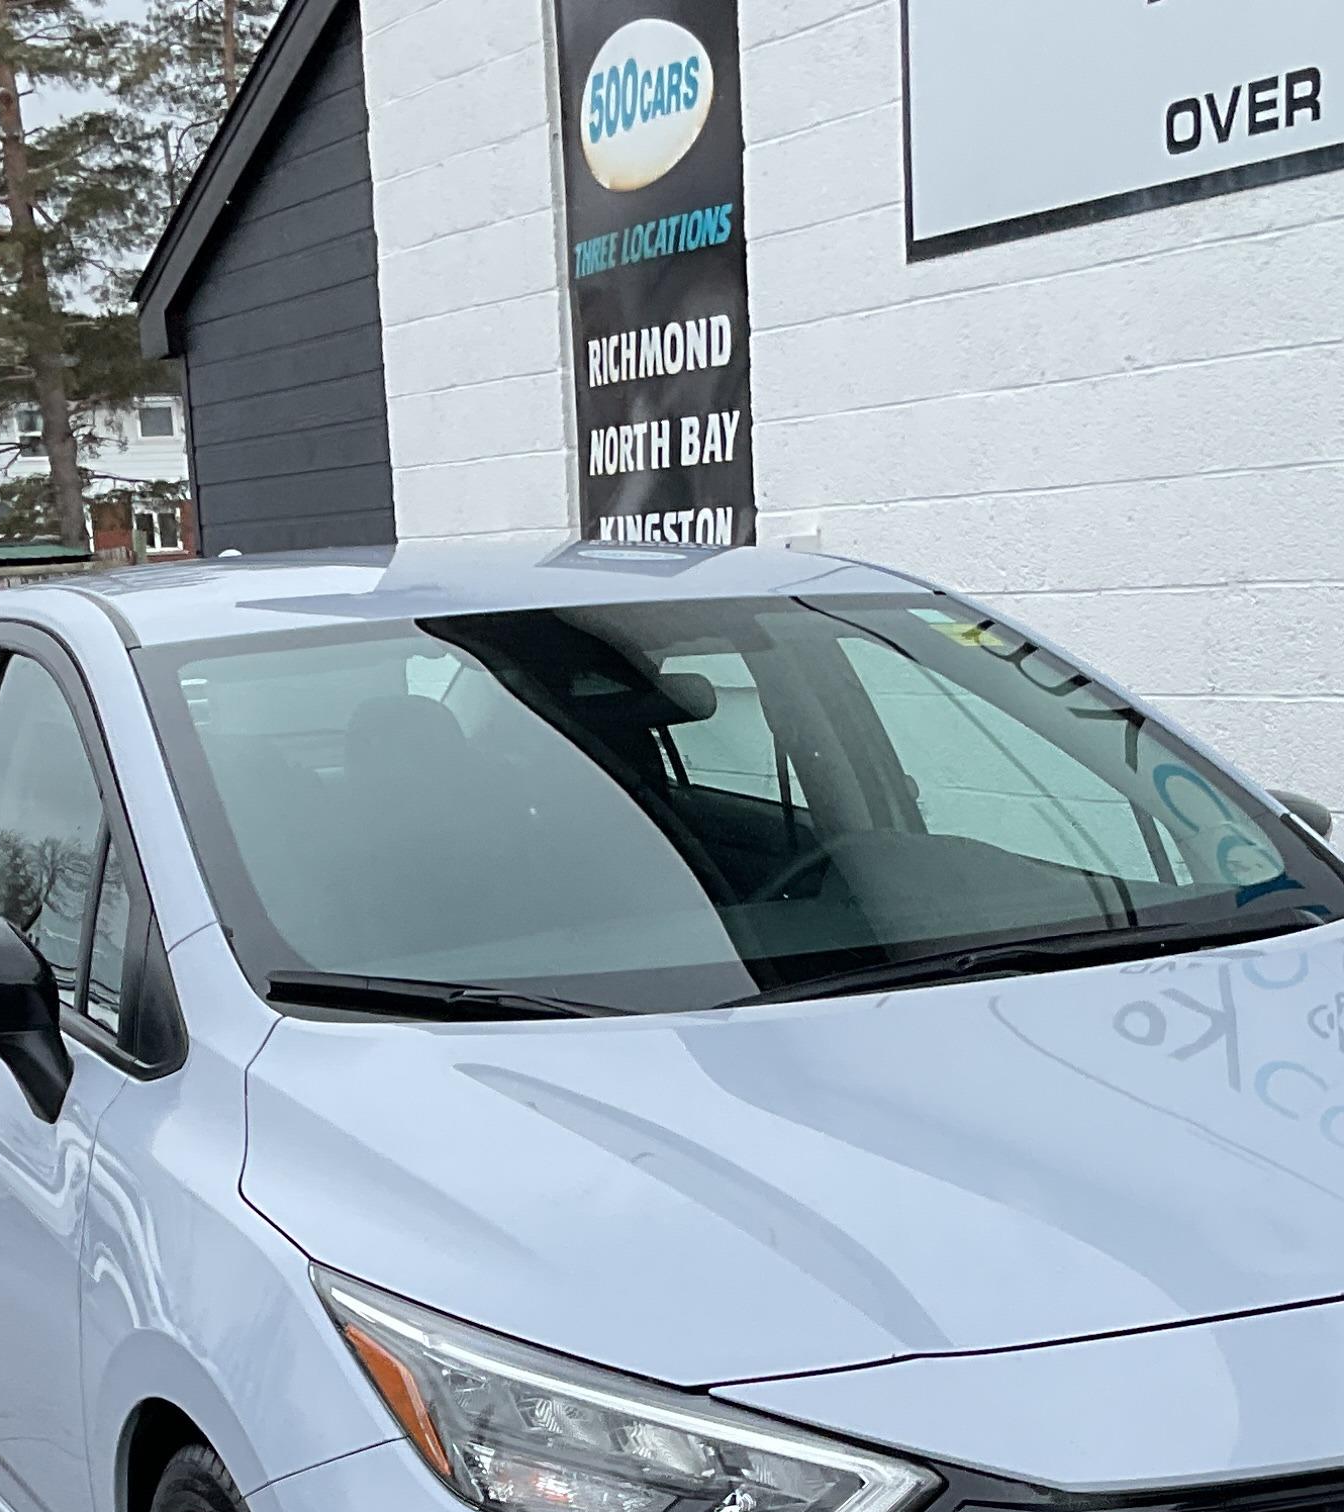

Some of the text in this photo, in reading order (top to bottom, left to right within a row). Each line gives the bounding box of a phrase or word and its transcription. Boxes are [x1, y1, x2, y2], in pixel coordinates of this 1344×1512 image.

[1166, 66, 1321, 155] OVER
[574, 203, 734, 280] THREE LOCATIONS
[587, 314, 732, 389] RICHMOND
[588, 410, 741, 477] NORTH BAY
[599, 506, 734, 544] KINGSTON
